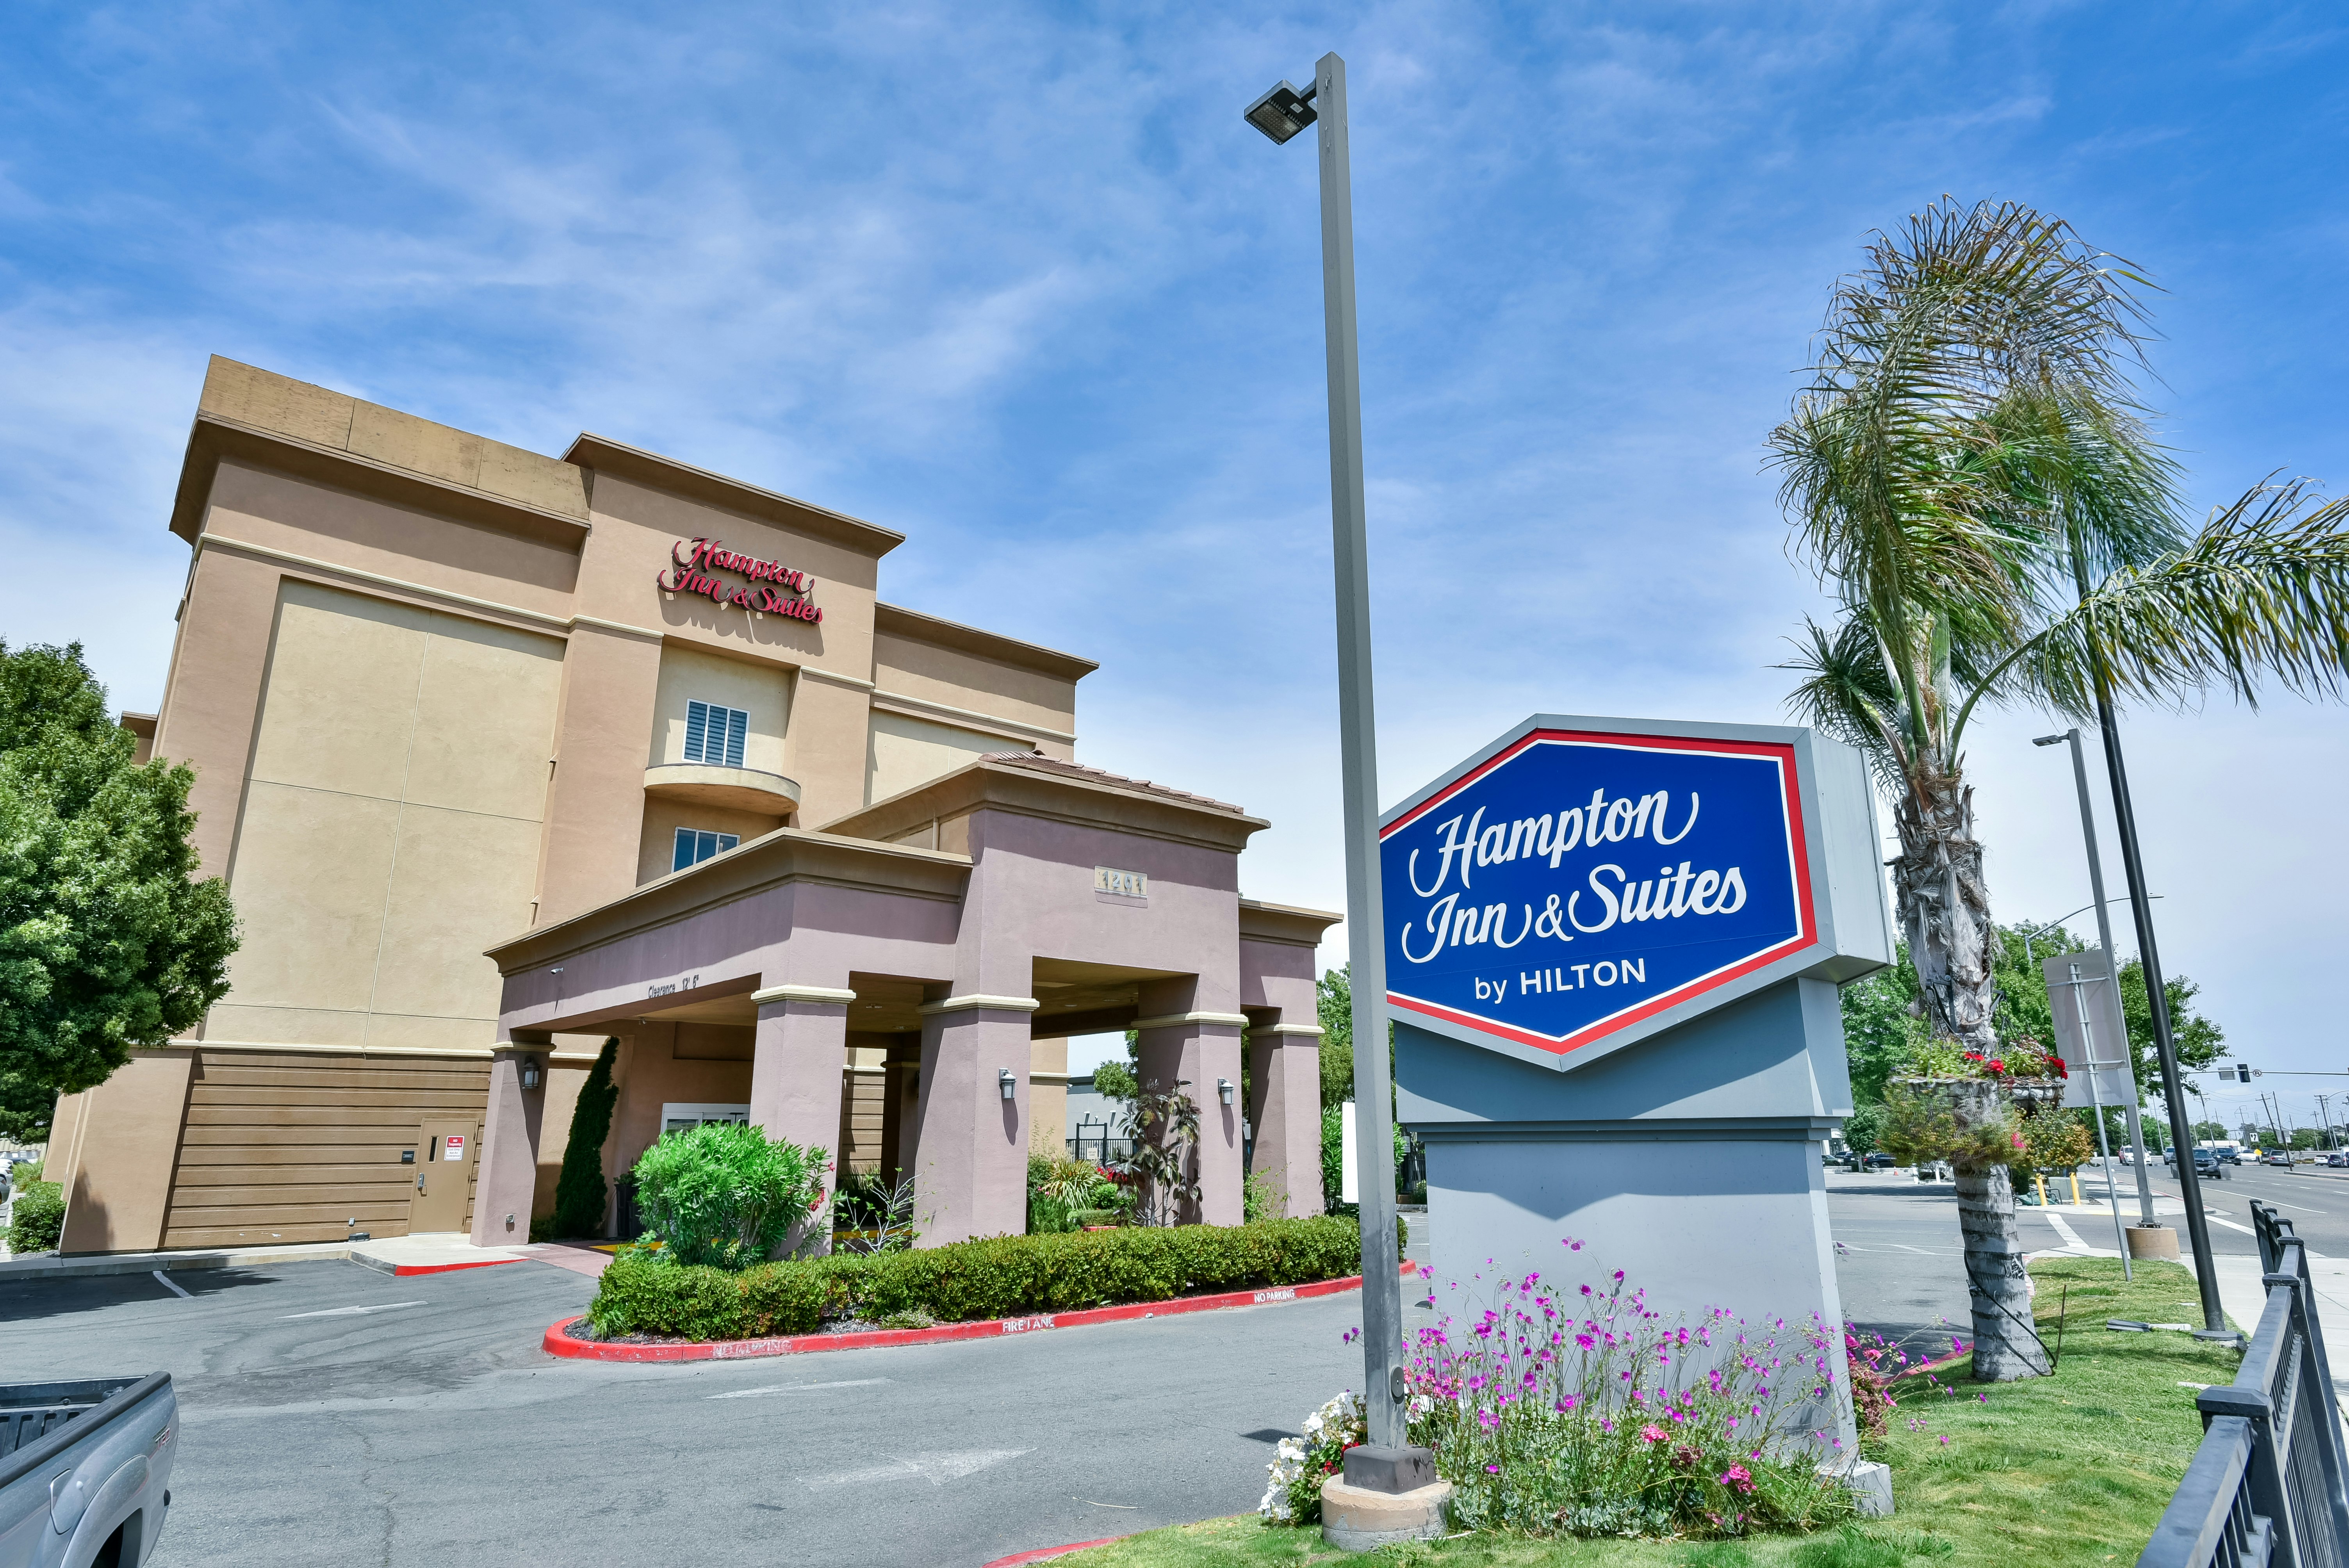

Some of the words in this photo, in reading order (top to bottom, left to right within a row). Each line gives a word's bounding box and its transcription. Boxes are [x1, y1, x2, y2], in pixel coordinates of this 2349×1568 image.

[672, 537, 815, 595] Hampton
[657, 567, 734, 604] Inn
[732, 588, 751, 611] &
[750, 586, 823, 625] Suites
[1409, 788, 1698, 897] Hampton
[1102, 871, 1142, 891] 1201
[1402, 893, 1532, 963] Inn
[1535, 894, 1574, 941] &
[1568, 861, 1747, 932] Suites
[649, 983, 675, 998] Clearance
[1475, 977, 1507, 1003] by
[1520, 958, 1646, 995] HILTON
[1254, 1293, 1265, 1303] NO
[1266, 1288, 1295, 1301] PARKING
[1002, 1319, 1024, 1333] FIRE
[155, 1427, 170, 1449] TRD
